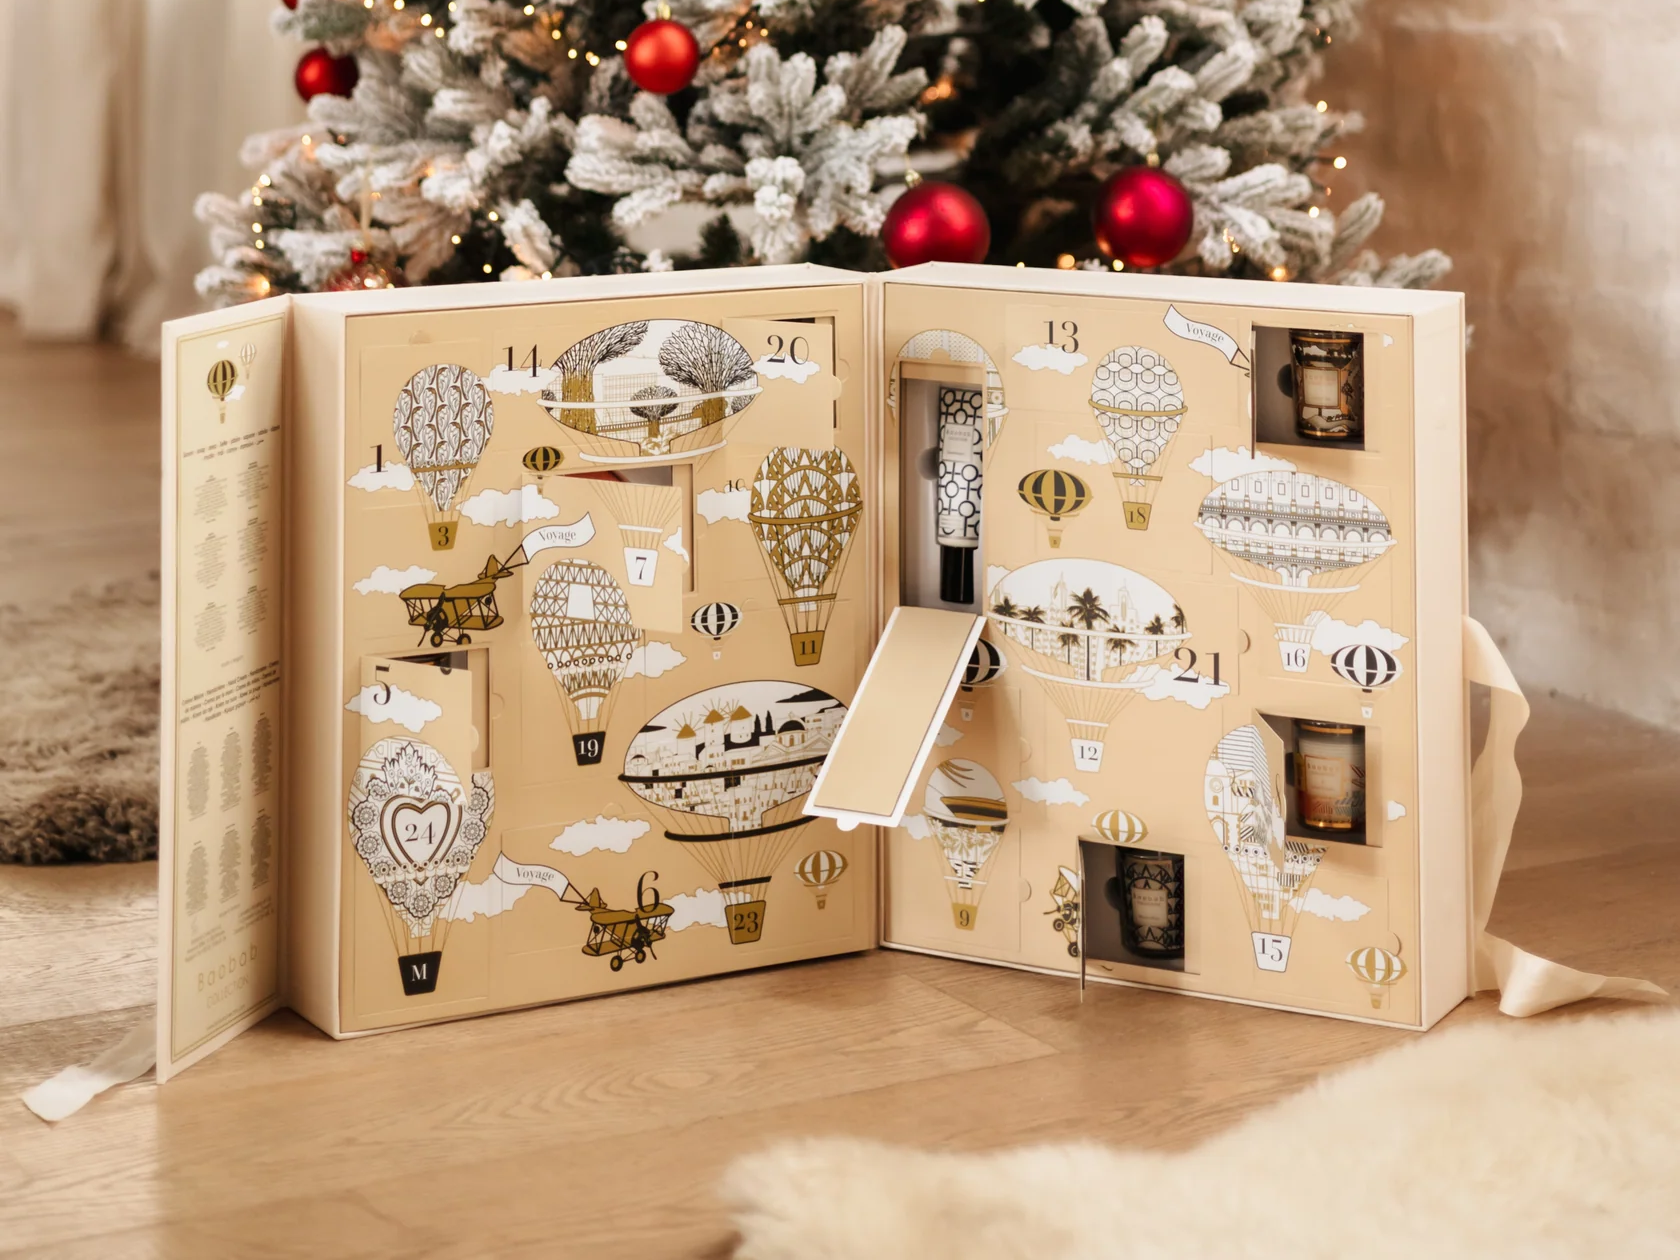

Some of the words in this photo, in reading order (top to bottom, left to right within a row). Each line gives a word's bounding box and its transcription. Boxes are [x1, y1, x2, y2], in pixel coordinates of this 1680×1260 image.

[1042, 320, 1079, 354] 13
[1185, 322, 1225, 344] Voyage
[766, 334, 810, 365] 20
[502, 344, 542, 378] 14
[369, 444, 388, 473] 1
[726, 478, 746, 492] 10
[1127, 507, 1147, 524] 18
[438, 526, 450, 547] 3
[537, 527, 577, 543] Voyage
[635, 556, 647, 581] 7
[799, 640, 818, 655] 11
[1284, 648, 1306, 669] 16
[1173, 647, 1229, 687] 21
[373, 664, 392, 706] 5
[577, 738, 599, 759] 19
[1077, 745, 1099, 761] 12
[404, 822, 436, 845] 24
[516, 866, 555, 882] Voyage
[636, 870, 660, 914] 6
[733, 911, 759, 934] 23
[959, 908, 971, 928] 9
[1257, 937, 1283, 962] 15
[197, 942, 258, 992] Baobab
[412, 965, 428, 981] M
